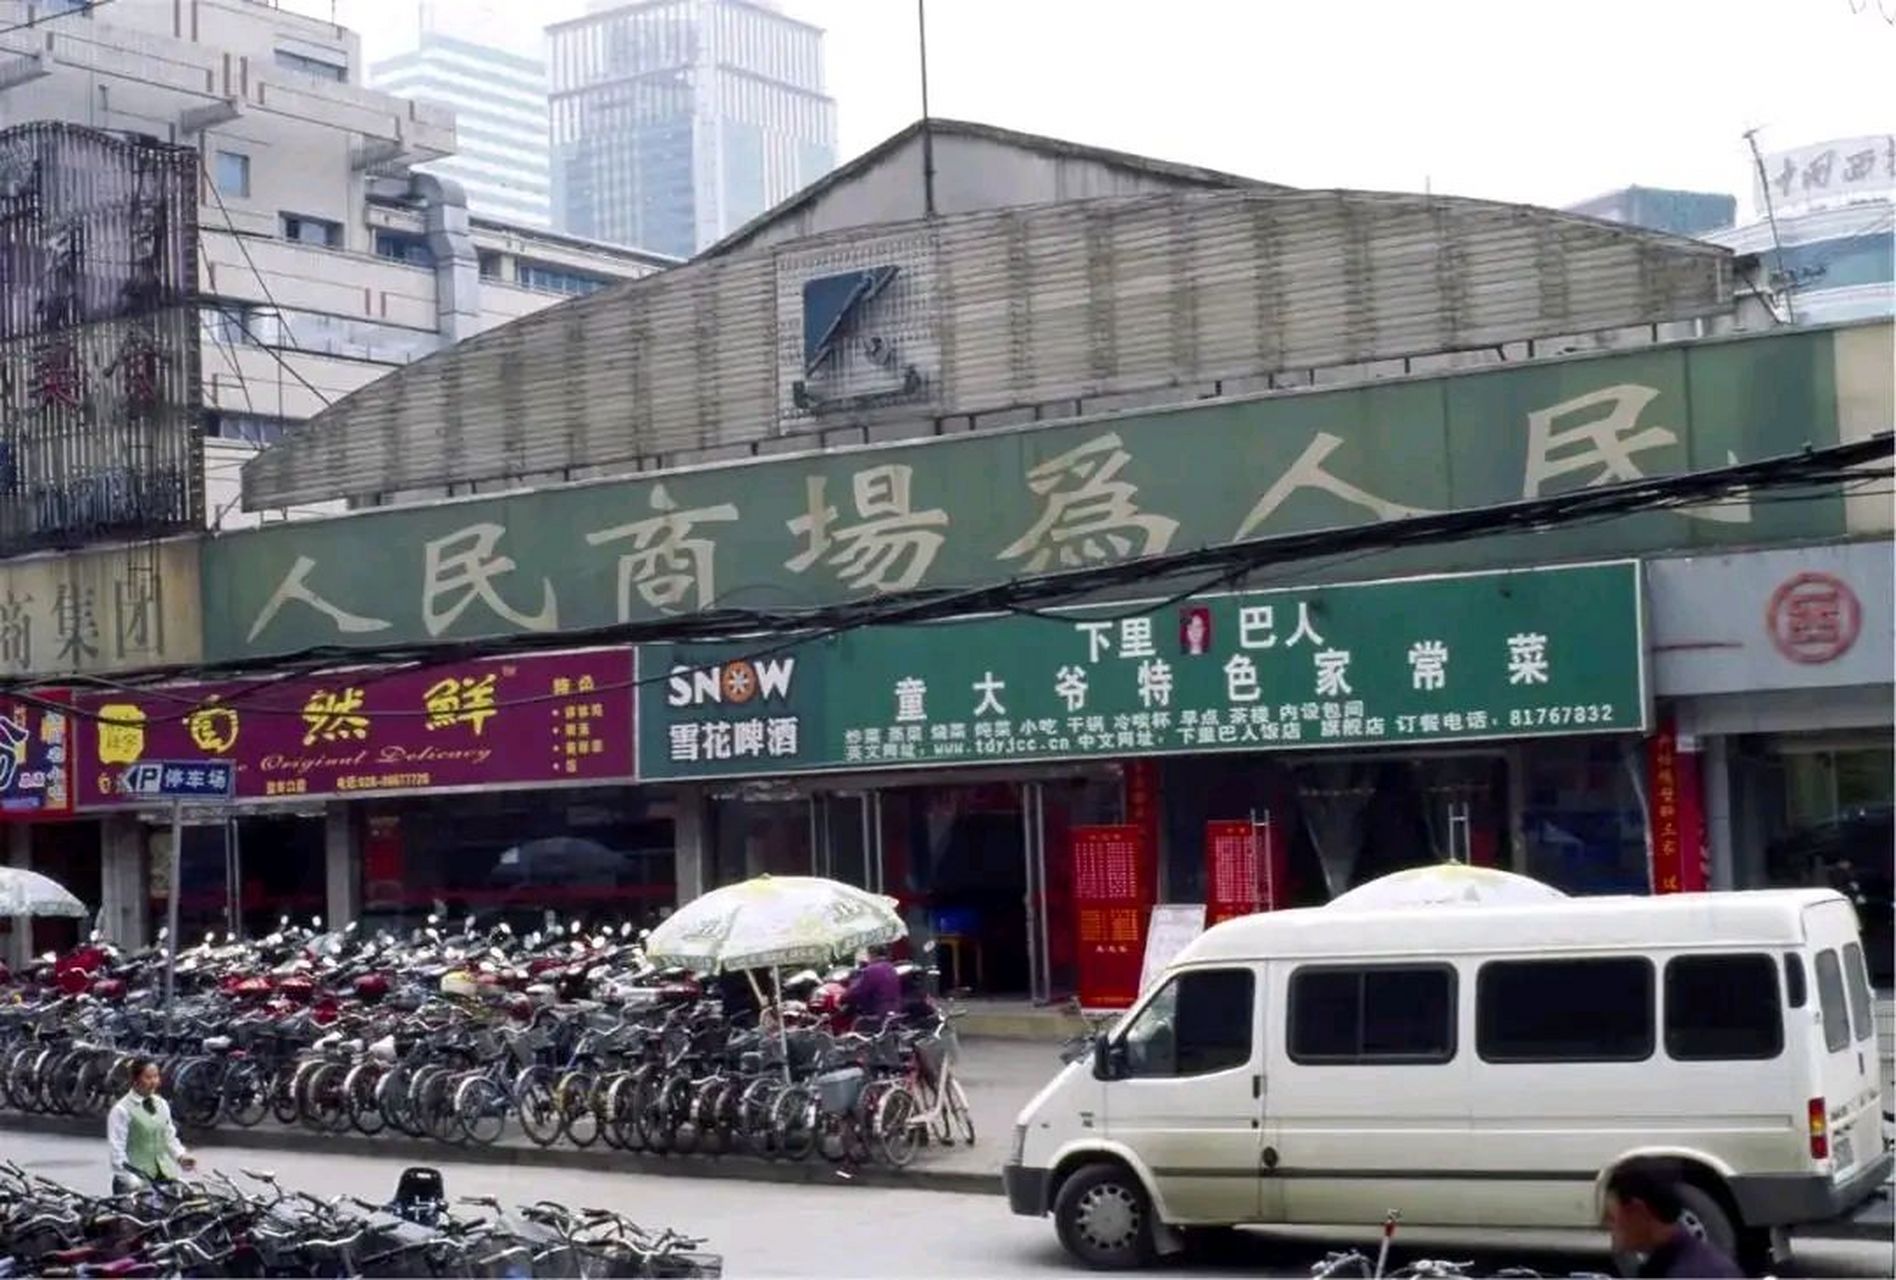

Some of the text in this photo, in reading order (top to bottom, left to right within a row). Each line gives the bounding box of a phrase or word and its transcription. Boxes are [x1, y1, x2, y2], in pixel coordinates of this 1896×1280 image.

[1075, 603, 1325, 664] 下里 巴人
[668, 659, 795, 707] SNOW
[893, 634, 1549, 722] 童大爷特色家常菜
[1020, 717, 1058, 737] 小吃
[1280, 701, 1364, 722] 内设包间
[1509, 704, 1614, 728] 81767832
[261, 752, 368, 775] Original
[377, 745, 492, 765] Delicacy
[668, 716, 799, 763] 雪花啤酒
[141, 768, 158, 790] P
[165, 768, 229, 791] 停车场
